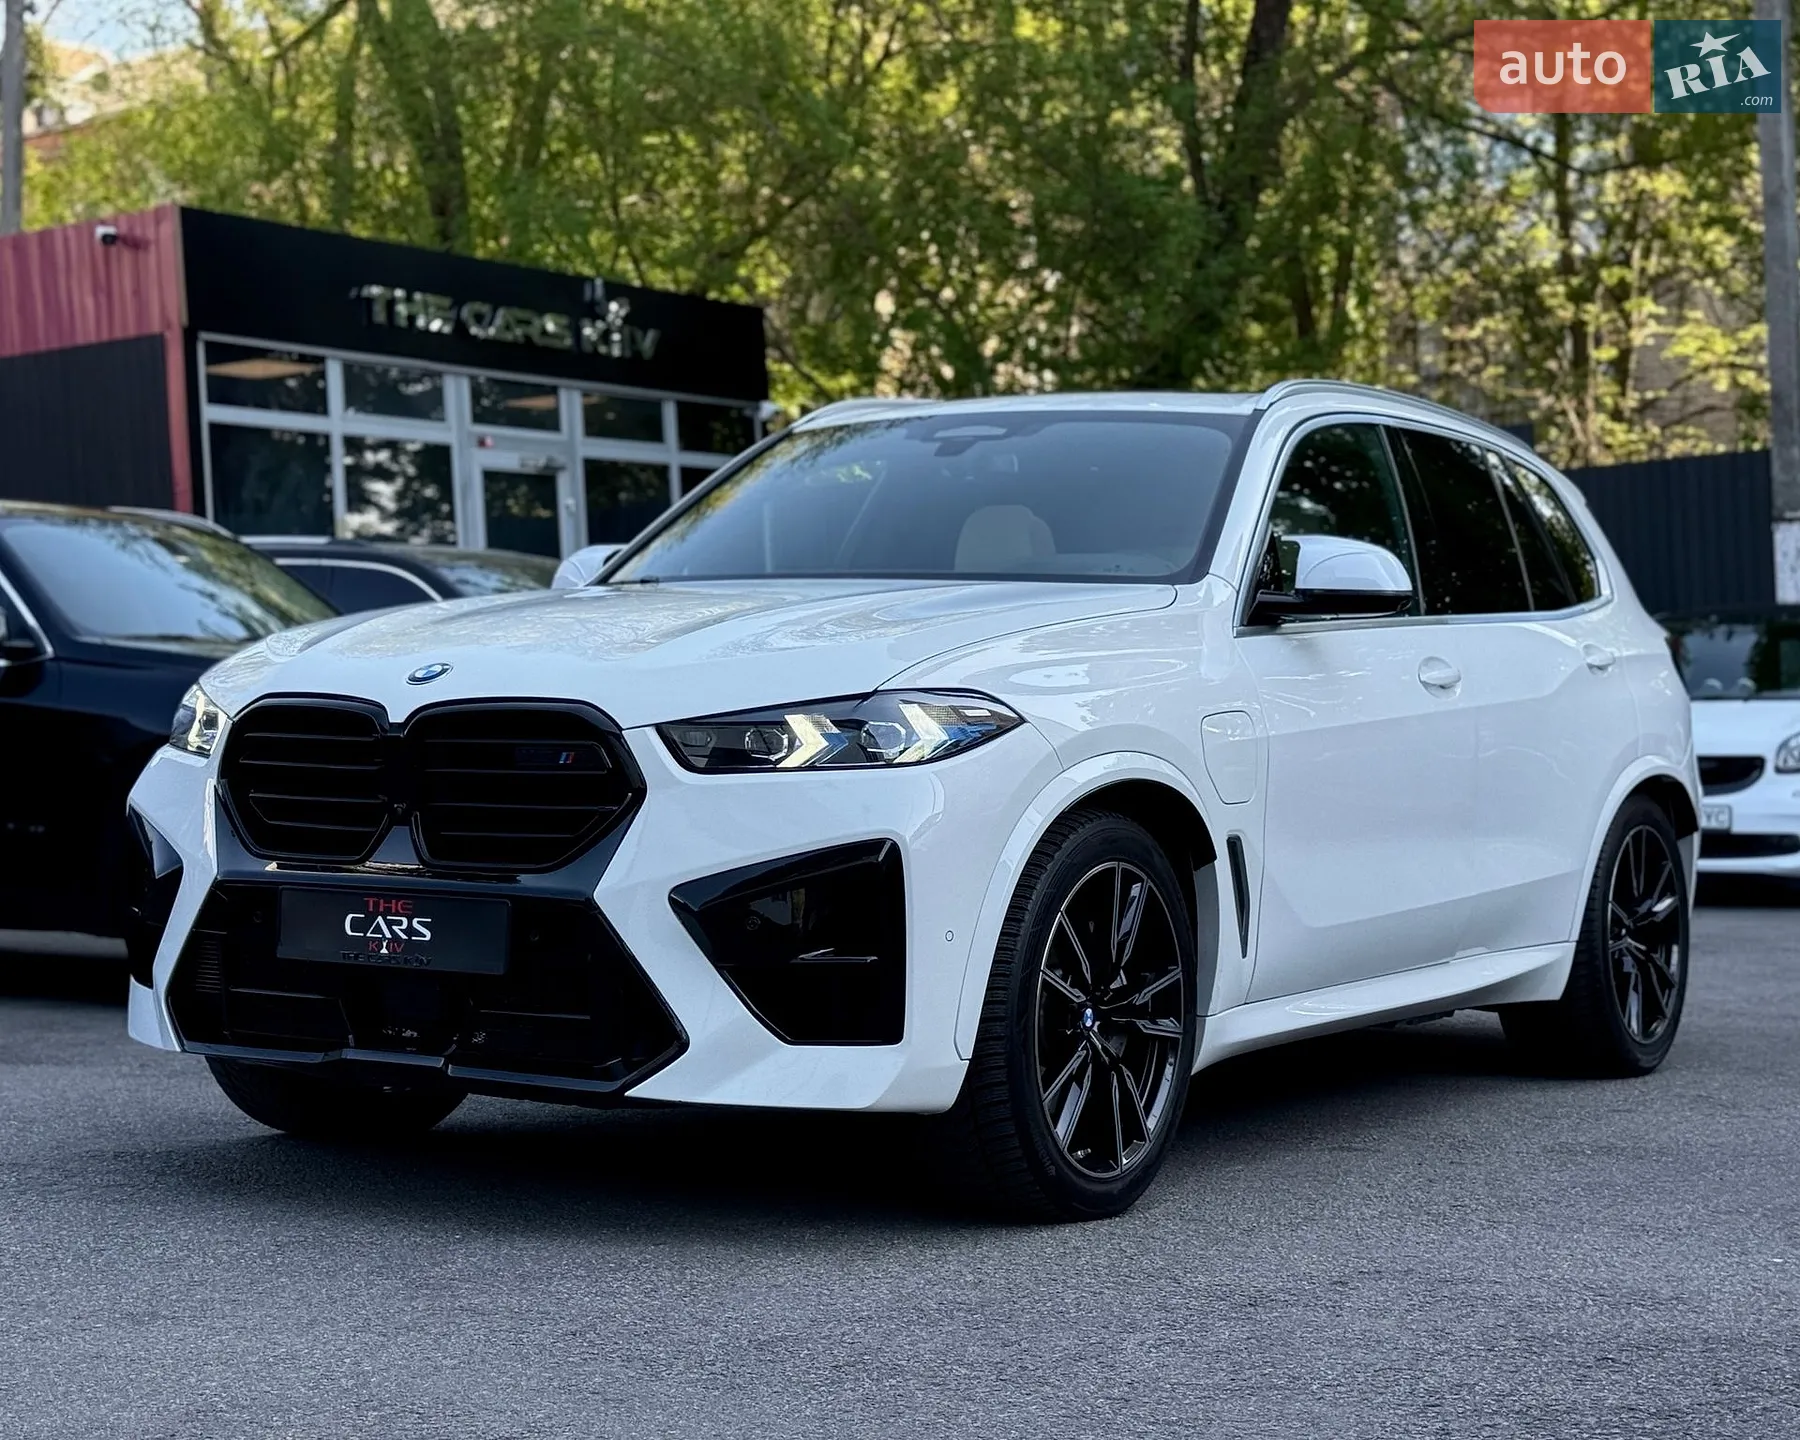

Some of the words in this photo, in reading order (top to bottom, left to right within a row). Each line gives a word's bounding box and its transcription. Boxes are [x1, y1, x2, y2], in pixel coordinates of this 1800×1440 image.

[355, 283, 454, 334] THE
[459, 299, 574, 349] CARS
[363, 897, 413, 914] THE
[344, 913, 432, 941] CARS
